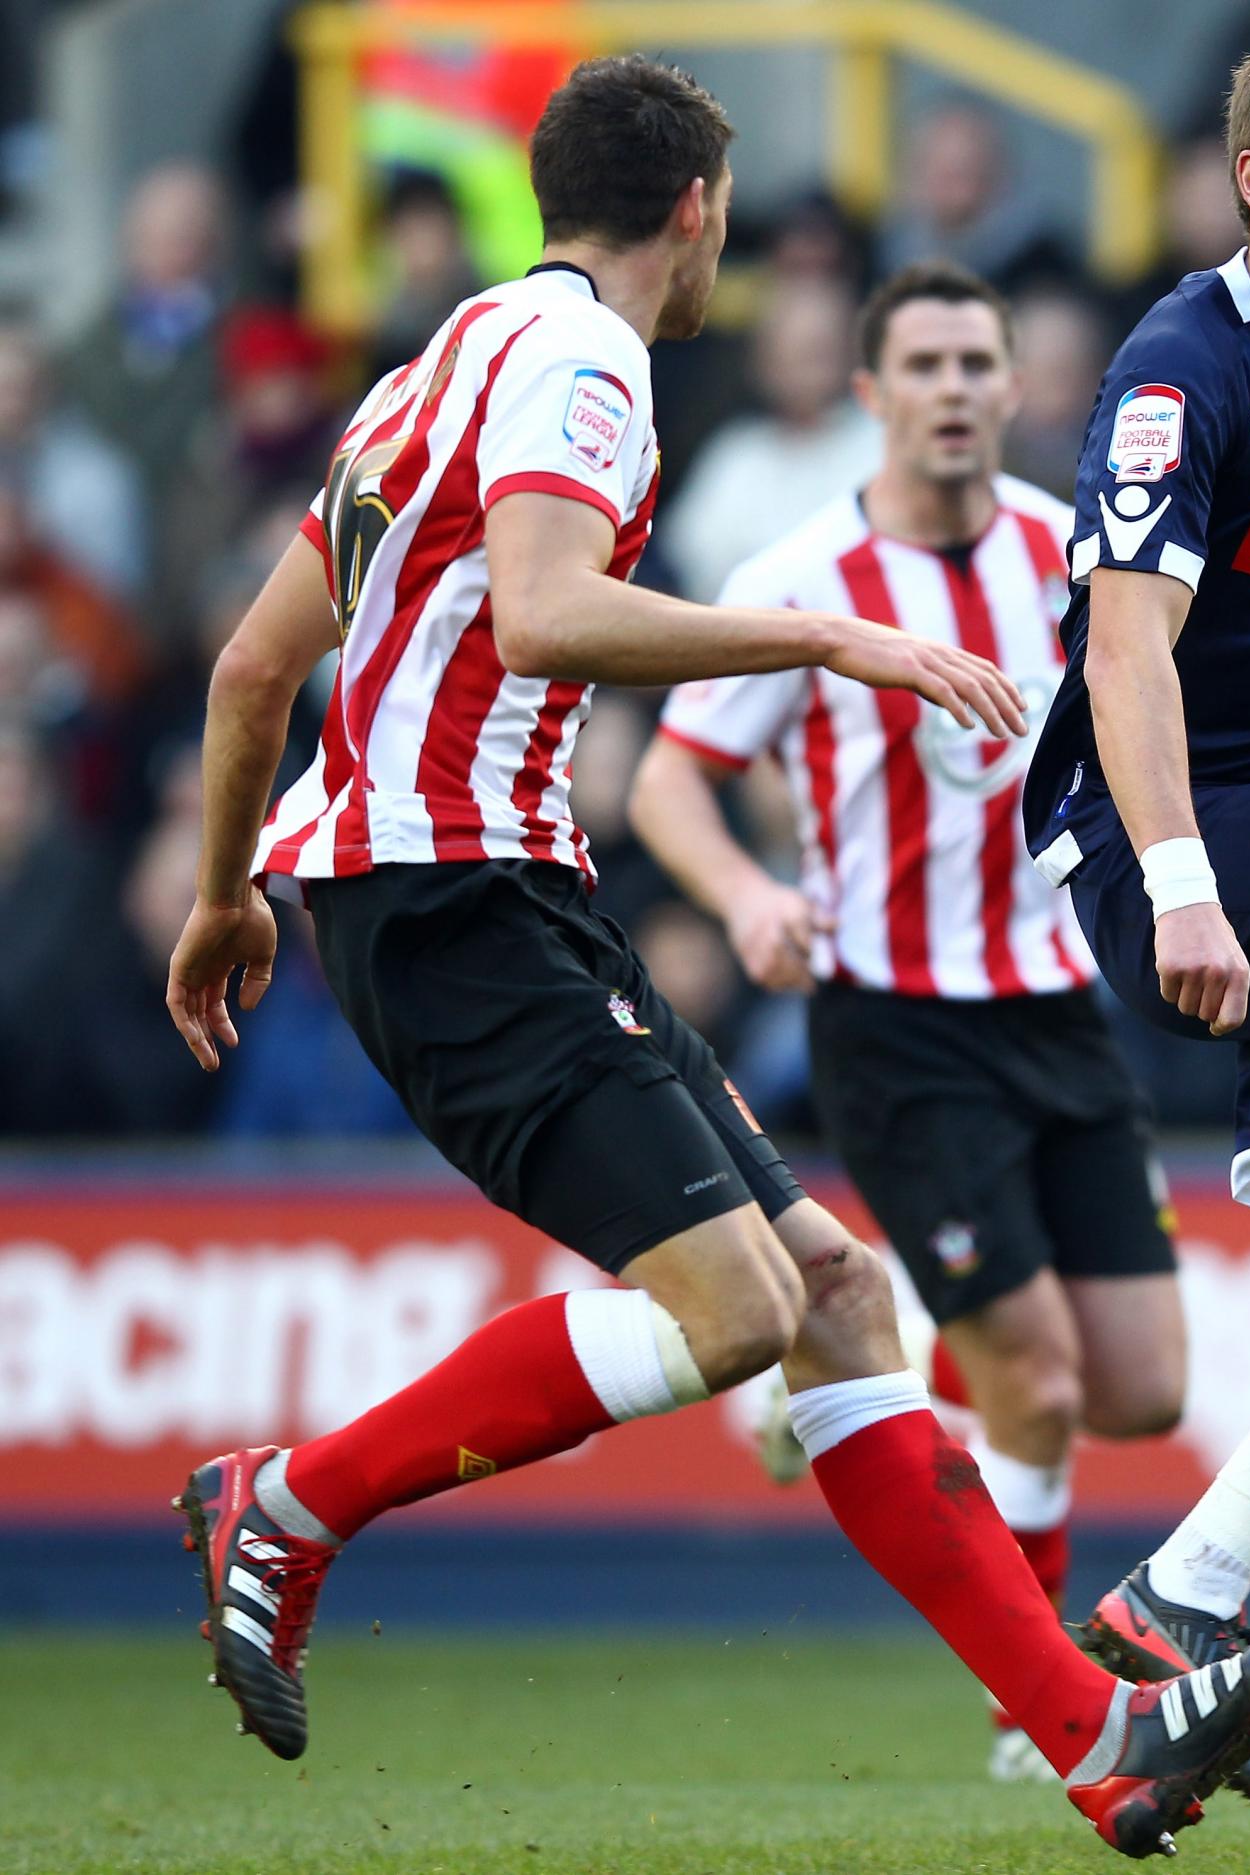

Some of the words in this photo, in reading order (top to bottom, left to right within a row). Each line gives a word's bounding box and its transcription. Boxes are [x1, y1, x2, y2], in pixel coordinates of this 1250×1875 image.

[1120, 412, 1177, 424] npower
[1119, 429, 1172, 438] FOOTBALL
[1117, 437, 1172, 449] LEAGUE
